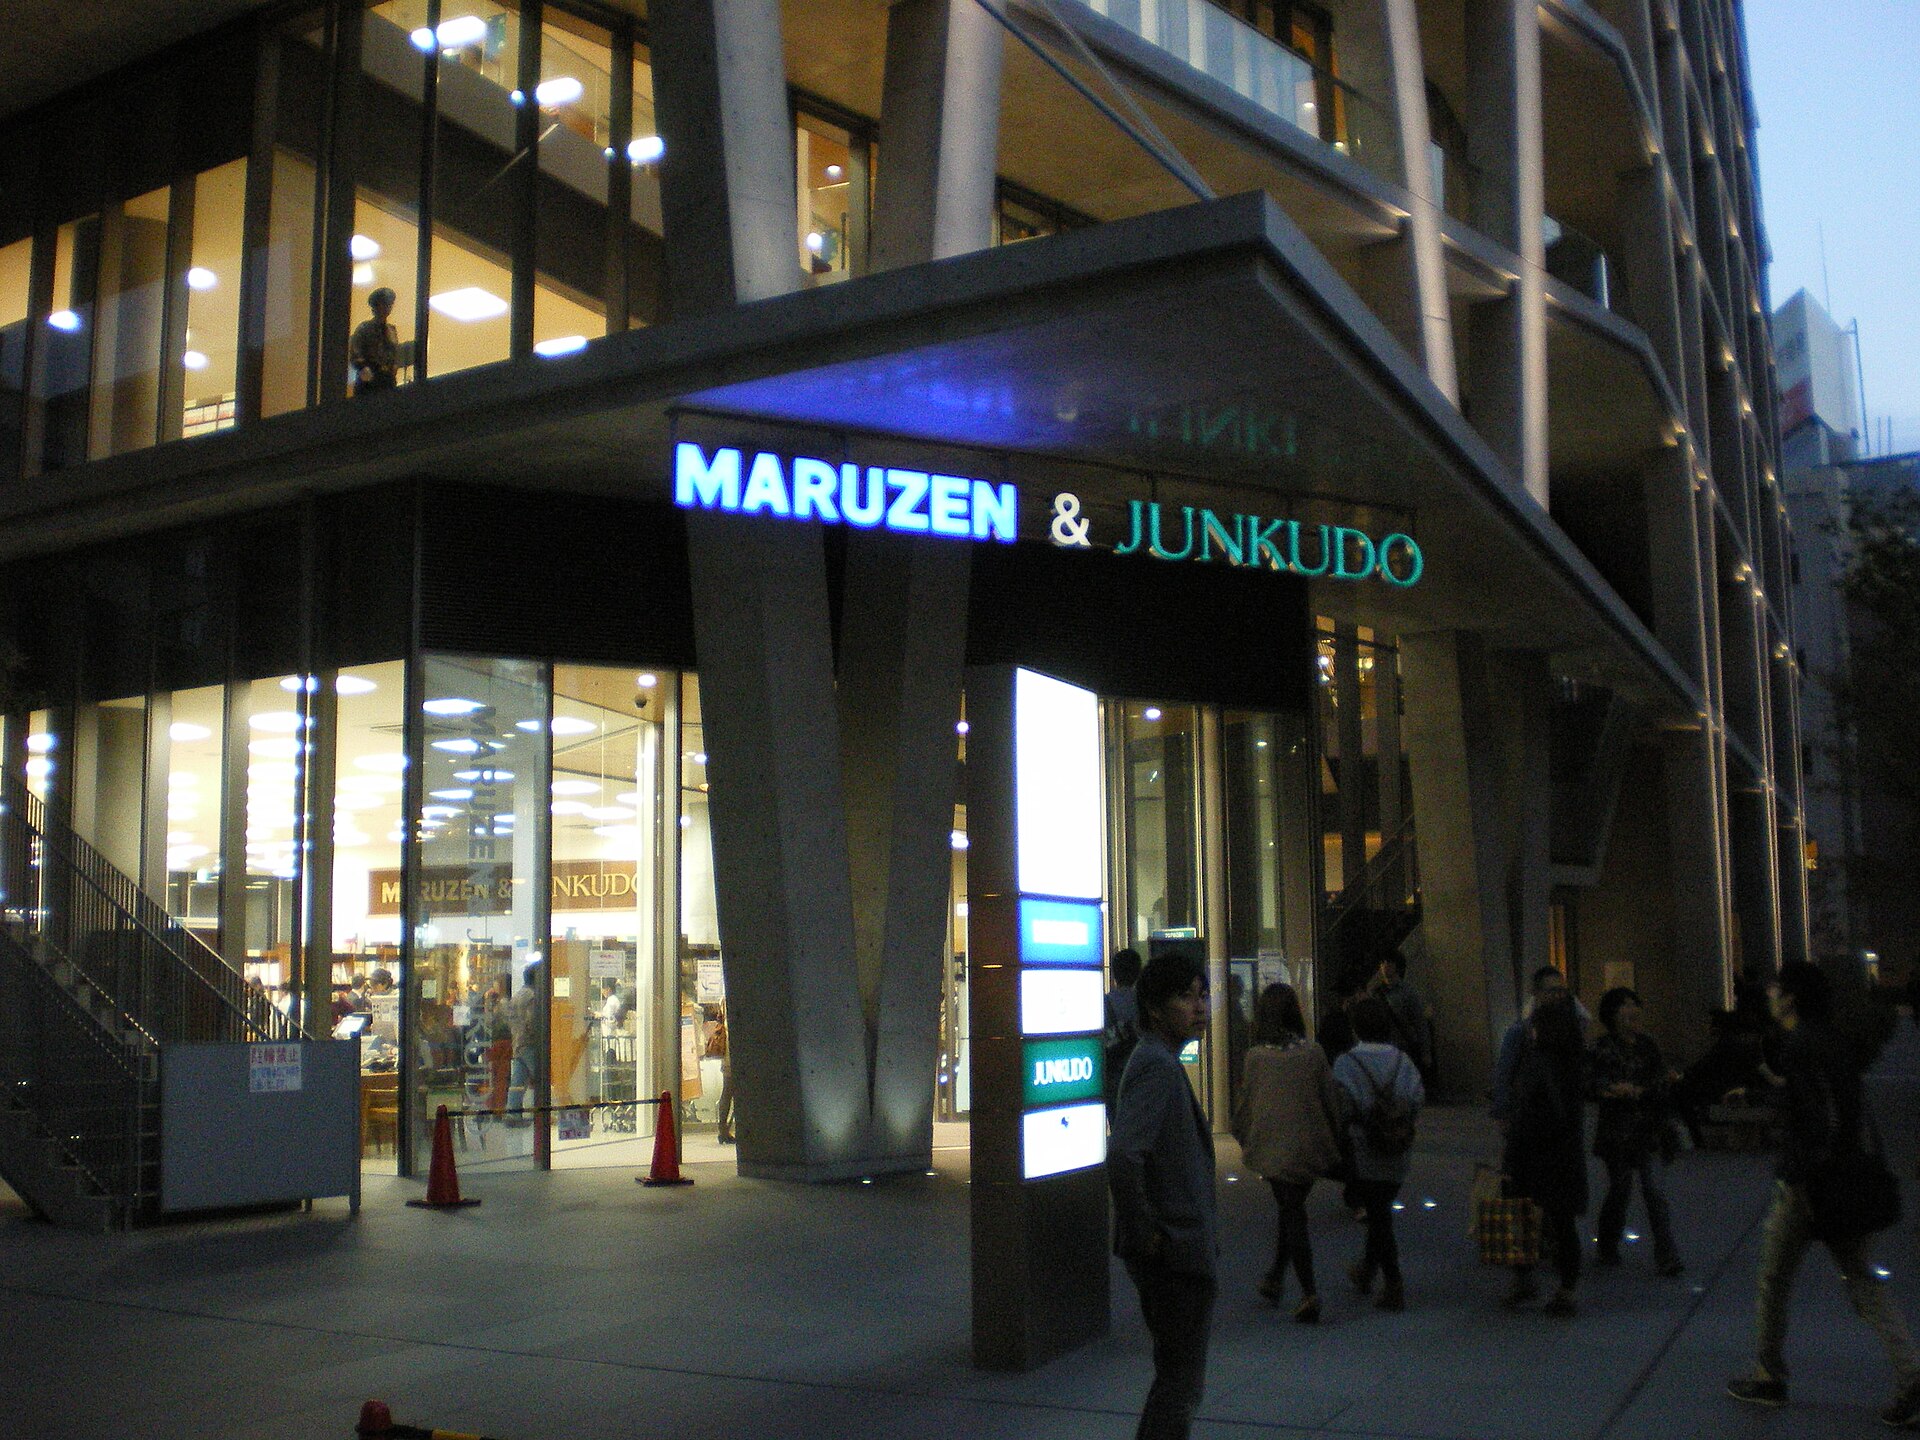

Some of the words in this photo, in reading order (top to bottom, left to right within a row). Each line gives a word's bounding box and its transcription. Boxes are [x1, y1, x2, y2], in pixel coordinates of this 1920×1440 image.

[676, 442, 1018, 543] MARUZEN
[1051, 492, 1091, 546] &
[1113, 500, 1423, 587] JUNKUDO
[381, 879, 489, 904] MRUZEN
